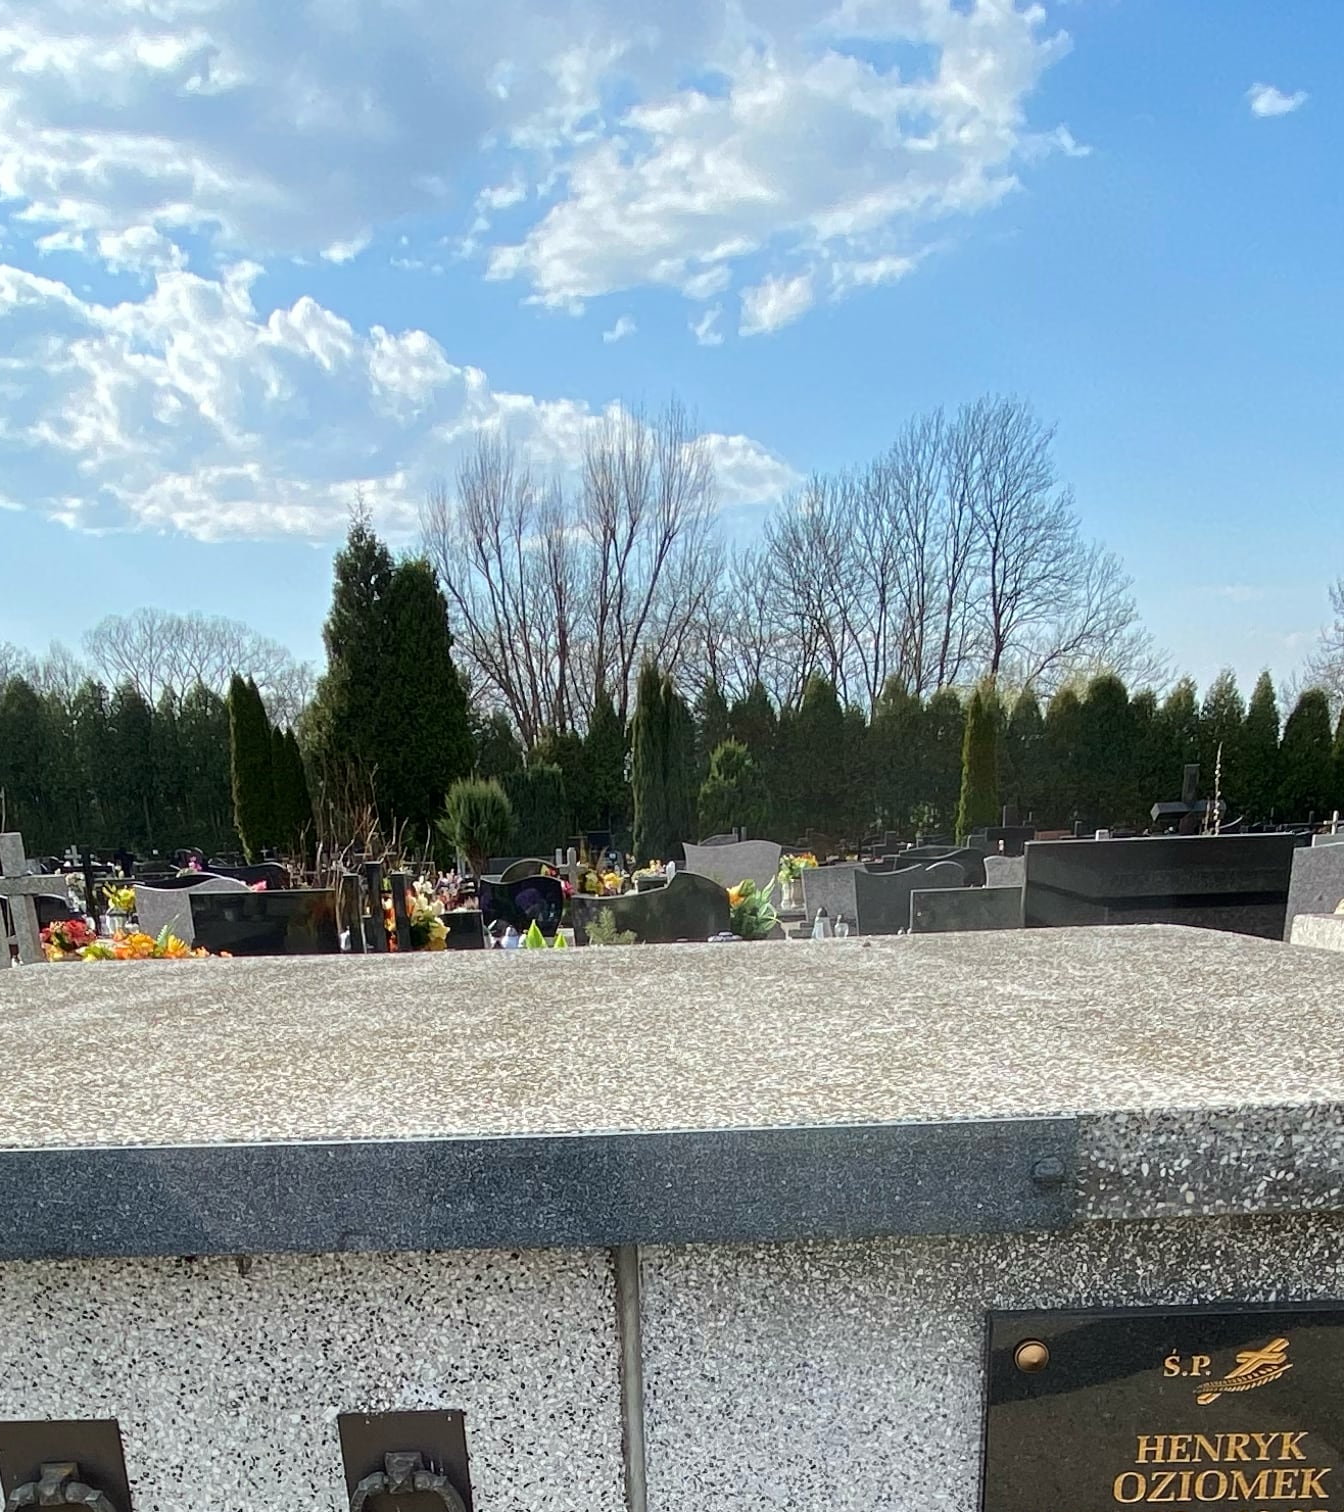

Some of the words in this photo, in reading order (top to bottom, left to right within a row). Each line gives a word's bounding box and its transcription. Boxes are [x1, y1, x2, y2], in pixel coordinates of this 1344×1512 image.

[1163, 1348, 1212, 1378] Ś.P.
[1134, 1430, 1310, 1464] HENRYK
[1112, 1467, 1333, 1504] OZIOMEK
